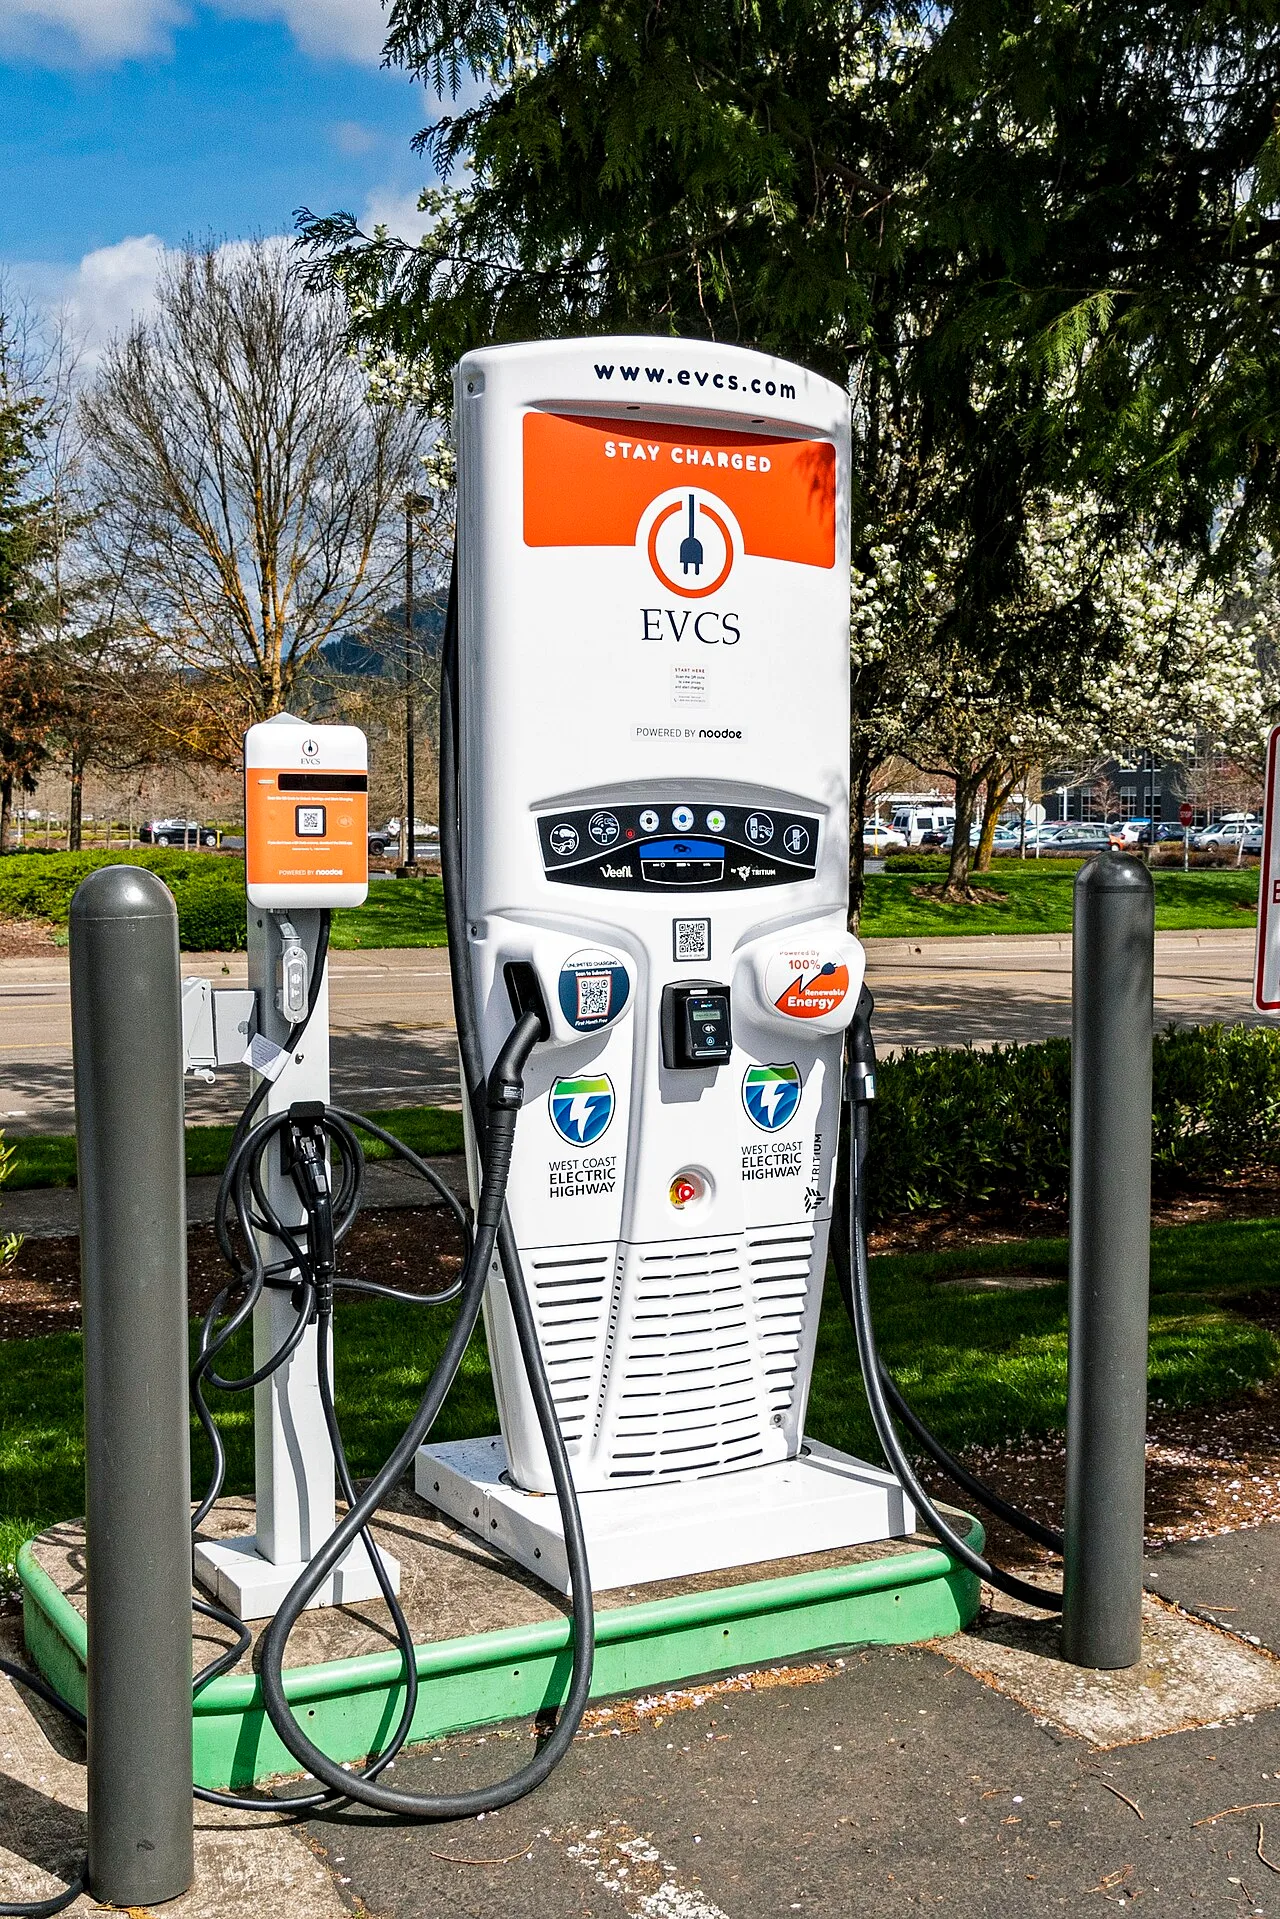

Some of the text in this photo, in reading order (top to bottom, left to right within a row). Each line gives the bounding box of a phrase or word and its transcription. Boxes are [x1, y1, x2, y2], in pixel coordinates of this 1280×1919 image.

[593, 362, 796, 400] www.evcs.com
[604, 441, 772, 473] STAY CHARGED
[640, 608, 741, 646] EVCS
[636, 727, 742, 740] POWERED BY noodoe
[300, 757, 321, 765] EVCS
[315, 868, 343, 876] noodoe
[600, 864, 633, 878] Veefil
[566, 961, 593, 969] UNLIMITED
[788, 959, 821, 970] 100%
[804, 988, 846, 997] Renewable
[787, 995, 835, 1010] Energy
[741, 1141, 803, 1156] WEST COAST
[548, 1156, 617, 1172] WEST COAST
[742, 1152, 802, 1168] ELECTRIC
[811, 1133, 823, 1183] TRITIUM
[550, 1167, 616, 1185] ELECTRIC
[742, 1165, 802, 1181] HIGHWAY
[550, 1181, 616, 1198] HIGHWAY
